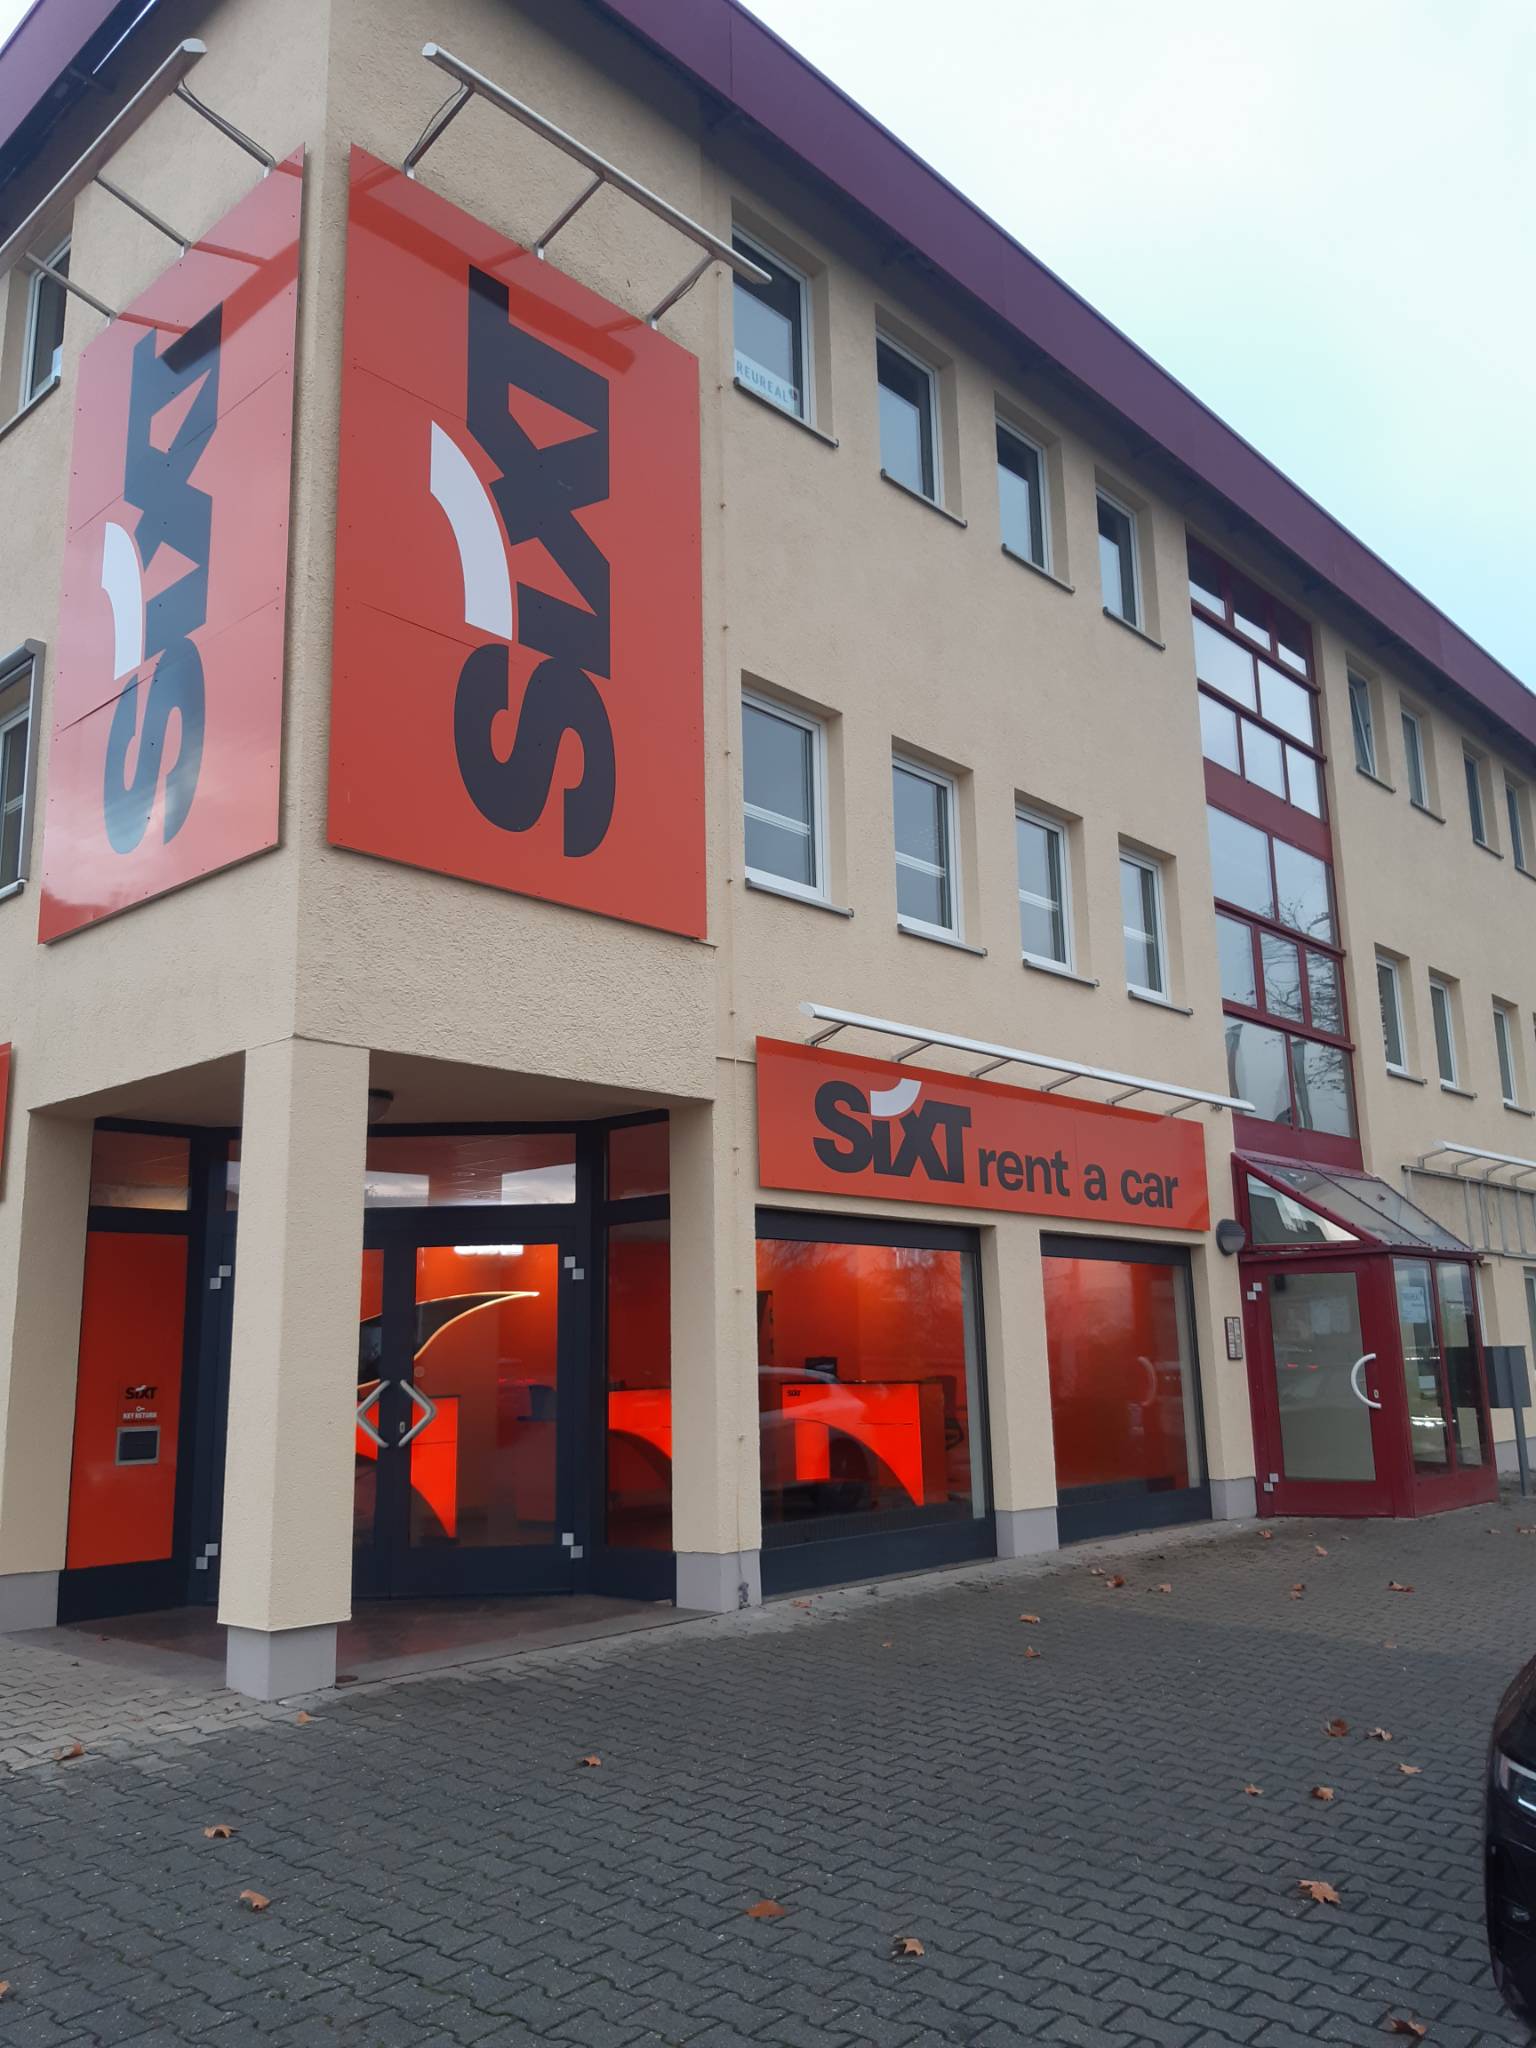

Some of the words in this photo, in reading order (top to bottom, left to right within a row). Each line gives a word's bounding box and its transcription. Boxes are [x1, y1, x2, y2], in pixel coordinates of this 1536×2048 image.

[978, 1148, 1070, 1197] rent
[1083, 1164, 1107, 1201] a
[1120, 1168, 1179, 1209] car
